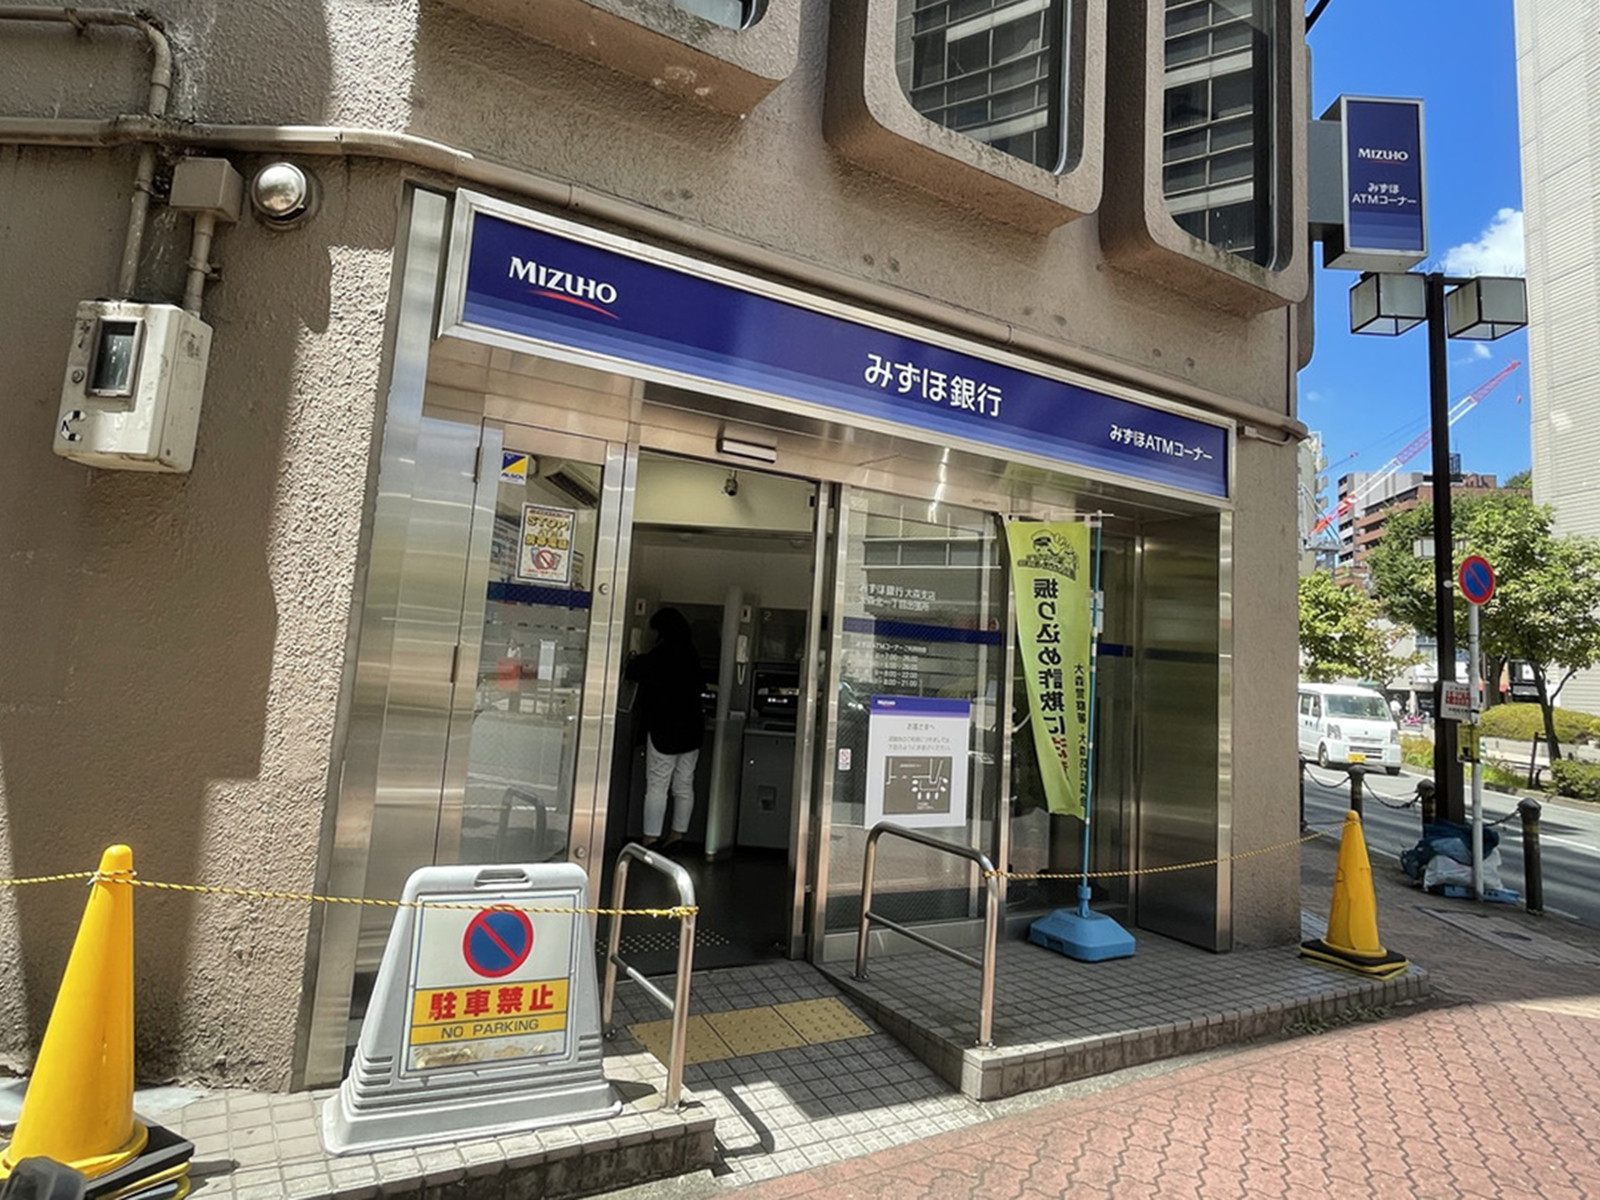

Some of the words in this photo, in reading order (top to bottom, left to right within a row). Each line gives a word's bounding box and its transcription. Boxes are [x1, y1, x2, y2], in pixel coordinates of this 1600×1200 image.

[1358, 148, 1408, 161] MIZUHO
[1352, 193, 1417, 206] ATMコーナー
[1368, 182, 1399, 194] みずほ
[508, 256, 617, 304] MIZUHO
[864, 353, 1003, 417] みずほ銀行
[1109, 424, 1213, 461] みずほATMコーナー
[428, 984, 554, 1021] 駐車禁止
[441, 1025, 464, 1039] NO
[472, 1018, 540, 1036] PARKING
